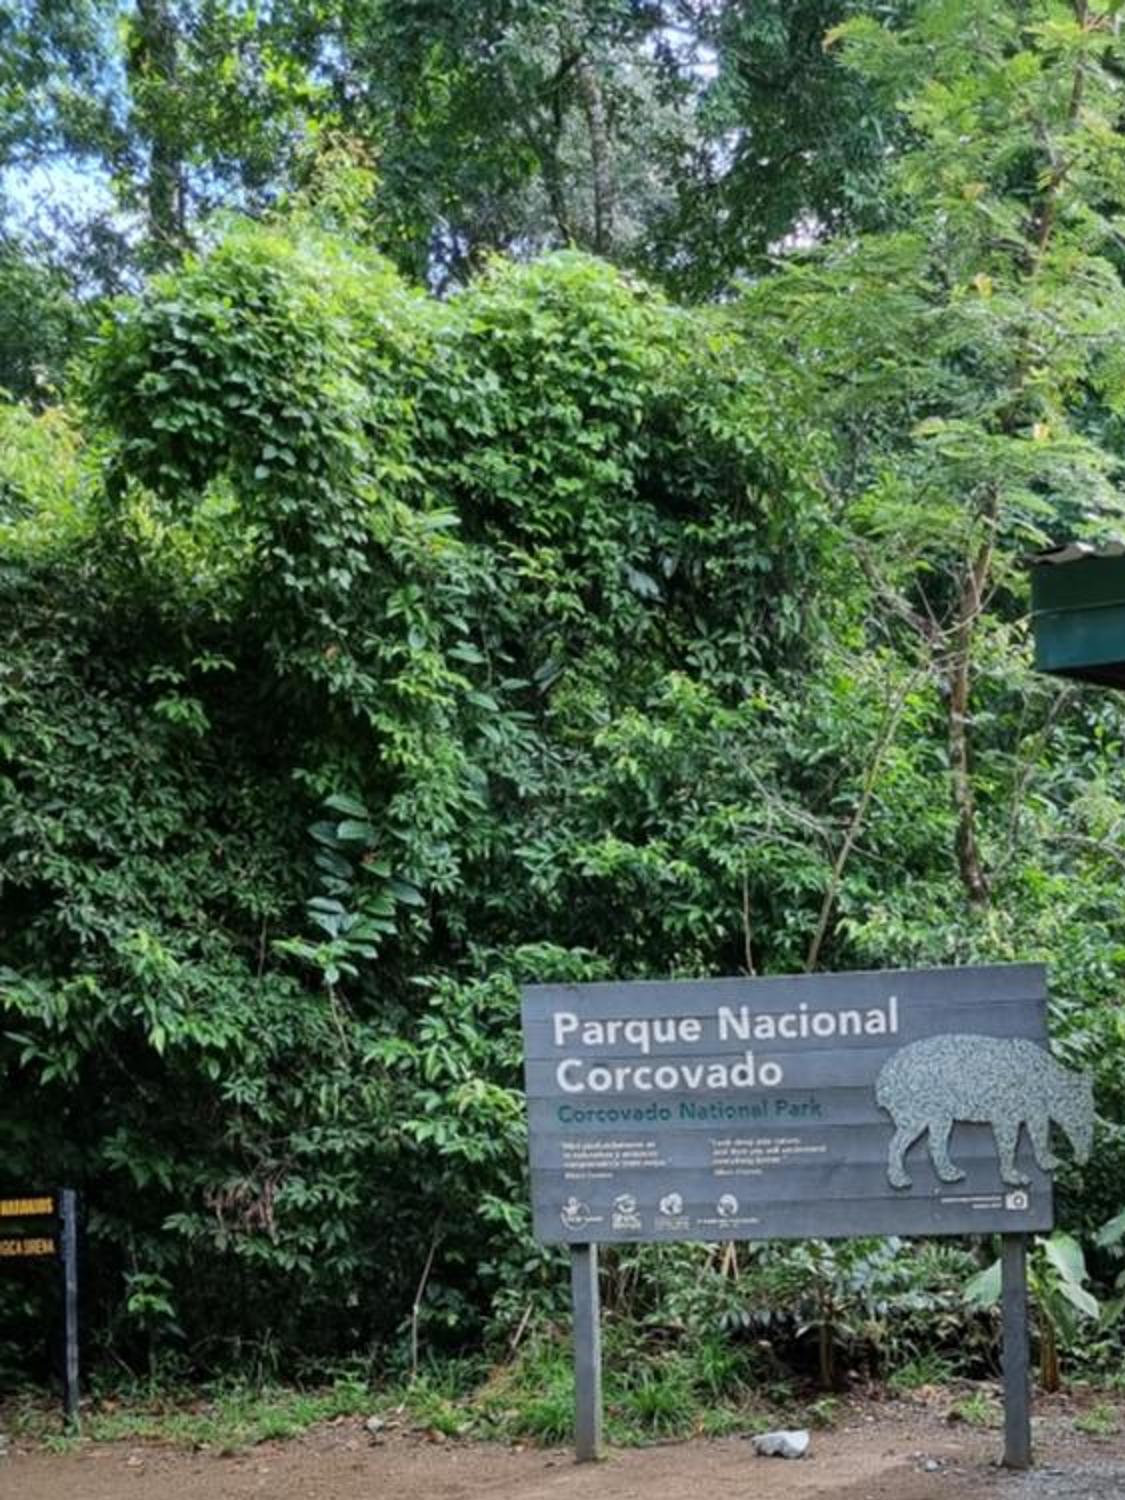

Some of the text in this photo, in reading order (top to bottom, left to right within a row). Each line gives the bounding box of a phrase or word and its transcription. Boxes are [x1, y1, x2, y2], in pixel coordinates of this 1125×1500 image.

[553, 996, 898, 1053] Parque Nacional
[556, 1051, 784, 1093] Corcovado
[558, 1098, 823, 1124] Corcovado National Park
